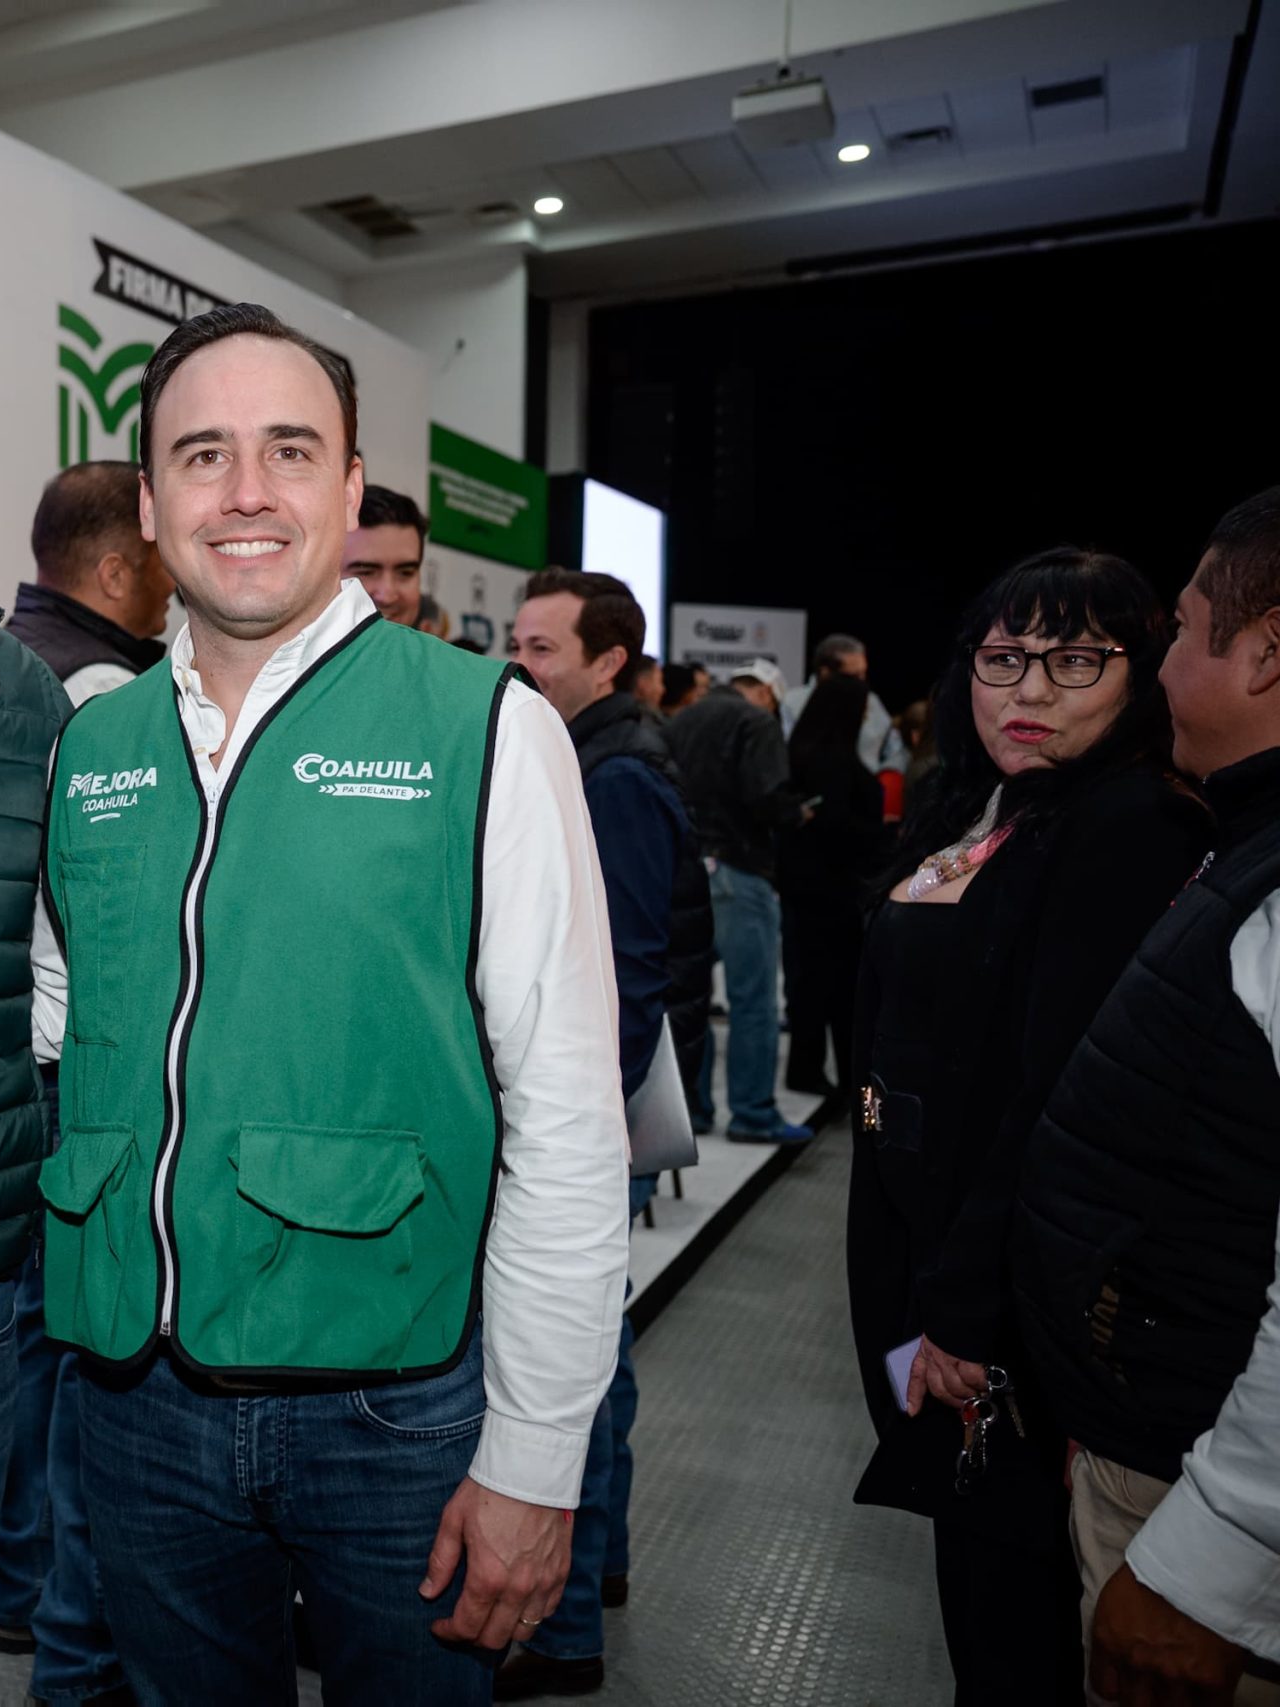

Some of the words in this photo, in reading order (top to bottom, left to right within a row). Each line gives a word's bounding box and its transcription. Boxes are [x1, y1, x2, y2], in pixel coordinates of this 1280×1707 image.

[108, 254, 184, 320] FIRMA
[66, 767, 158, 799] MEJORA
[292, 753, 434, 784] COAHUILA
[82, 793, 139, 813] COAHUILA
[359, 786, 408, 798] DELANTE
